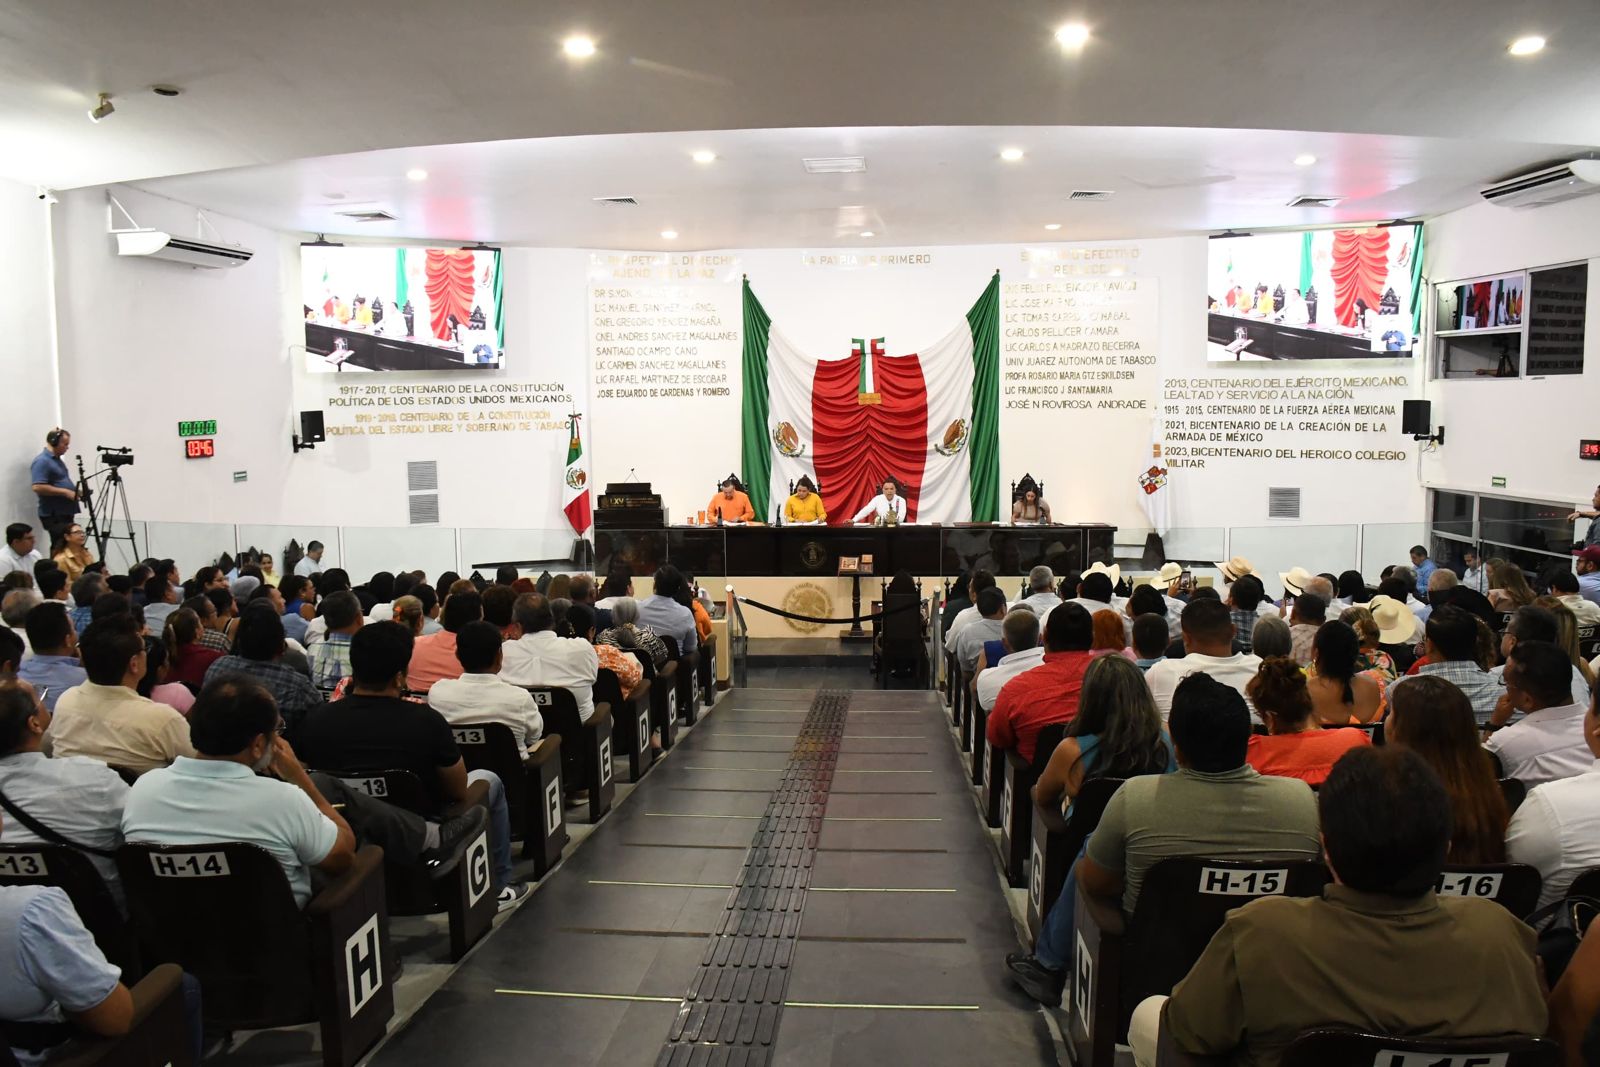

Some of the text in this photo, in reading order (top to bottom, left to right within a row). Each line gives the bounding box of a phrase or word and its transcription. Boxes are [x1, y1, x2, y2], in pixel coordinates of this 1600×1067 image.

[1006, 328, 1040, 337] CARLOS
[1043, 327, 1082, 337] PELLICER
[596, 346, 699, 356] SANTIAGO OCAMPO CANO
[1006, 343, 1017, 352] LIC
[1019, 342, 1050, 351] CARLOS
[1061, 341, 1100, 351] MADRAZO
[1103, 341, 1141, 350] BECERRA
[596, 360, 727, 370] LIC CARMEN SANCHEZ MAGALLANES
[1006, 355, 1157, 366] UNIV JUAREZ AUTONOMA DE TABASCO
[596, 375, 607, 384] LIC
[610, 375, 639, 384] RAFAEL
[642, 375, 679, 383] MARTINEZ
[694, 374, 727, 383] ESCOBAR
[1005, 371, 1136, 381] PROFA ROSARIO MARIA GTZ ESKILDSEN
[1164, 376, 1409, 389] 2013, CENTENARIO DEL EJÉRCITO MEXICANO.
[389, 384, 455, 394] CENTENARIO
[458, 384, 471, 394] DE
[474, 384, 488, 393] LA
[490, 381, 565, 393] CONSTITUCIÓN
[597, 389, 614, 399] JOSE
[616, 389, 648, 398] EDUARDO
[650, 389, 659, 398] DE
[660, 388, 694, 397] CARDENAS
[703, 387, 731, 396] ROMERO
[1005, 386, 1016, 395] LIC
[1018, 385, 1059, 395] FRANCISCO
[1067, 385, 1114, 394] SANTAMARIA
[329, 393, 573, 406] POLÍTICA DE LOS ESTADOS UNIDOS MEXICANOS
[1164, 390, 1214, 400] LEALTAD
[1217, 390, 1224, 399] Y
[1226, 390, 1279, 400] SERVICIO
[1291, 390, 1307, 399] LA
[1005, 399, 1148, 410] JOSÉ N ROVIROSA ANDRADE
[1164, 405, 1181, 415] 1915
[1207, 405, 1257, 414] CENTENARIO
[1260, 405, 1271, 414] DE
[1273, 405, 1285, 414] LA
[1287, 405, 1320, 415] FUERZA
[1322, 403, 1351, 415] AÉREA
[1353, 405, 1397, 415] MEXICANA
[536, 420, 571, 431] TABASC
[1165, 419, 1388, 432] 2021, BICENTENARIO DE LA CREACIÓN DE LA
[1165, 429, 1264, 442] ARMADA DE MÉXICO
[1164, 446, 1407, 460] 2023, BICENTENARIO DEL HEROICO COLEGIO
[641, 717, 648, 749] D
[601, 743, 610, 781] E
[548, 784, 557, 831] F
[155, 855, 222, 876] H-14
[470, 844, 487, 897] G
[1031, 852, 1041, 907] G
[1206, 870, 1279, 894] H-15
[350, 926, 379, 1008] H
[1078, 942, 1091, 1029] H
